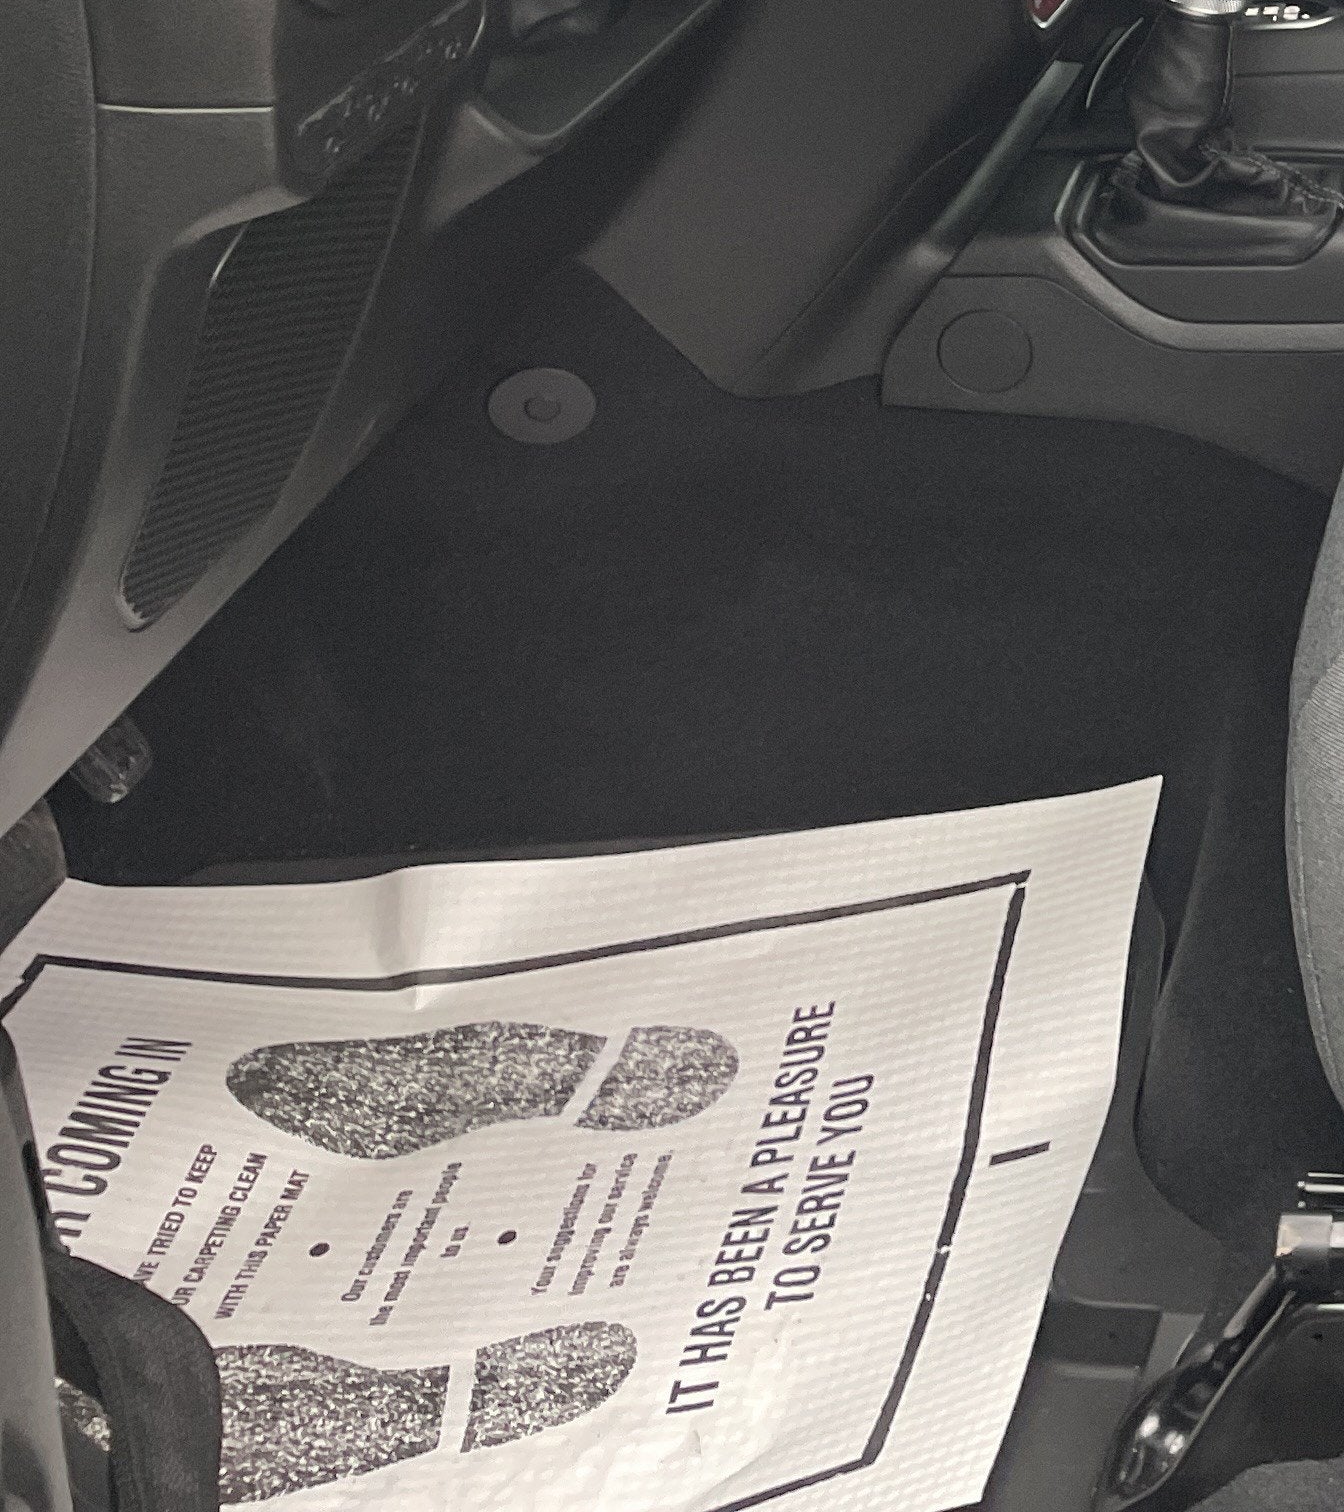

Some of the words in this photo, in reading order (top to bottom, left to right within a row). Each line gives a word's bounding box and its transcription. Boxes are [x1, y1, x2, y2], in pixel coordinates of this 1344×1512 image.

[41, 1064, 172, 1196] COMING
[114, 1037, 192, 1061] IN
[749, 1000, 836, 1169] PLEASURE
[816, 1073, 875, 1146] YOU
[148, 1211, 185, 1255] TRIED
[172, 1187, 198, 1207] TO
[185, 1143, 217, 1184] KEEP
[607, 1153, 638, 1200] service
[638, 1150, 674, 1212] welcome.
[741, 1172, 790, 1195] A
[782, 1150, 857, 1255] SERVE
[184, 1205, 241, 1283] CARPETING
[229, 1152, 268, 1202] CLEAN
[214, 1275, 249, 1320] WITH
[235, 1249, 268, 1280] THIS
[255, 1204, 293, 1246] PAPER
[280, 1169, 310, 1200] MAT
[341, 1279, 367, 1302] Our
[358, 1213, 402, 1276] customers
[392, 1190, 413, 1209] are
[369, 1305, 394, 1326] the
[383, 1269, 411, 1302] most
[400, 1206, 442, 1267] important
[431, 1162, 463, 1204] people
[530, 1265, 556, 1296] Your
[546, 1184, 590, 1262] suggestions
[576, 1162, 597, 1181] for
[598, 1203, 618, 1224] our
[619, 1214, 650, 1261] always
[707, 1204, 779, 1288] BEEN
[440, 1245, 461, 1258] to
[567, 1227, 612, 1296] improving
[609, 1264, 630, 1288] are
[764, 1264, 821, 1311] TO
[679, 1295, 747, 1367] HAS
[665, 1379, 720, 1415] IT
